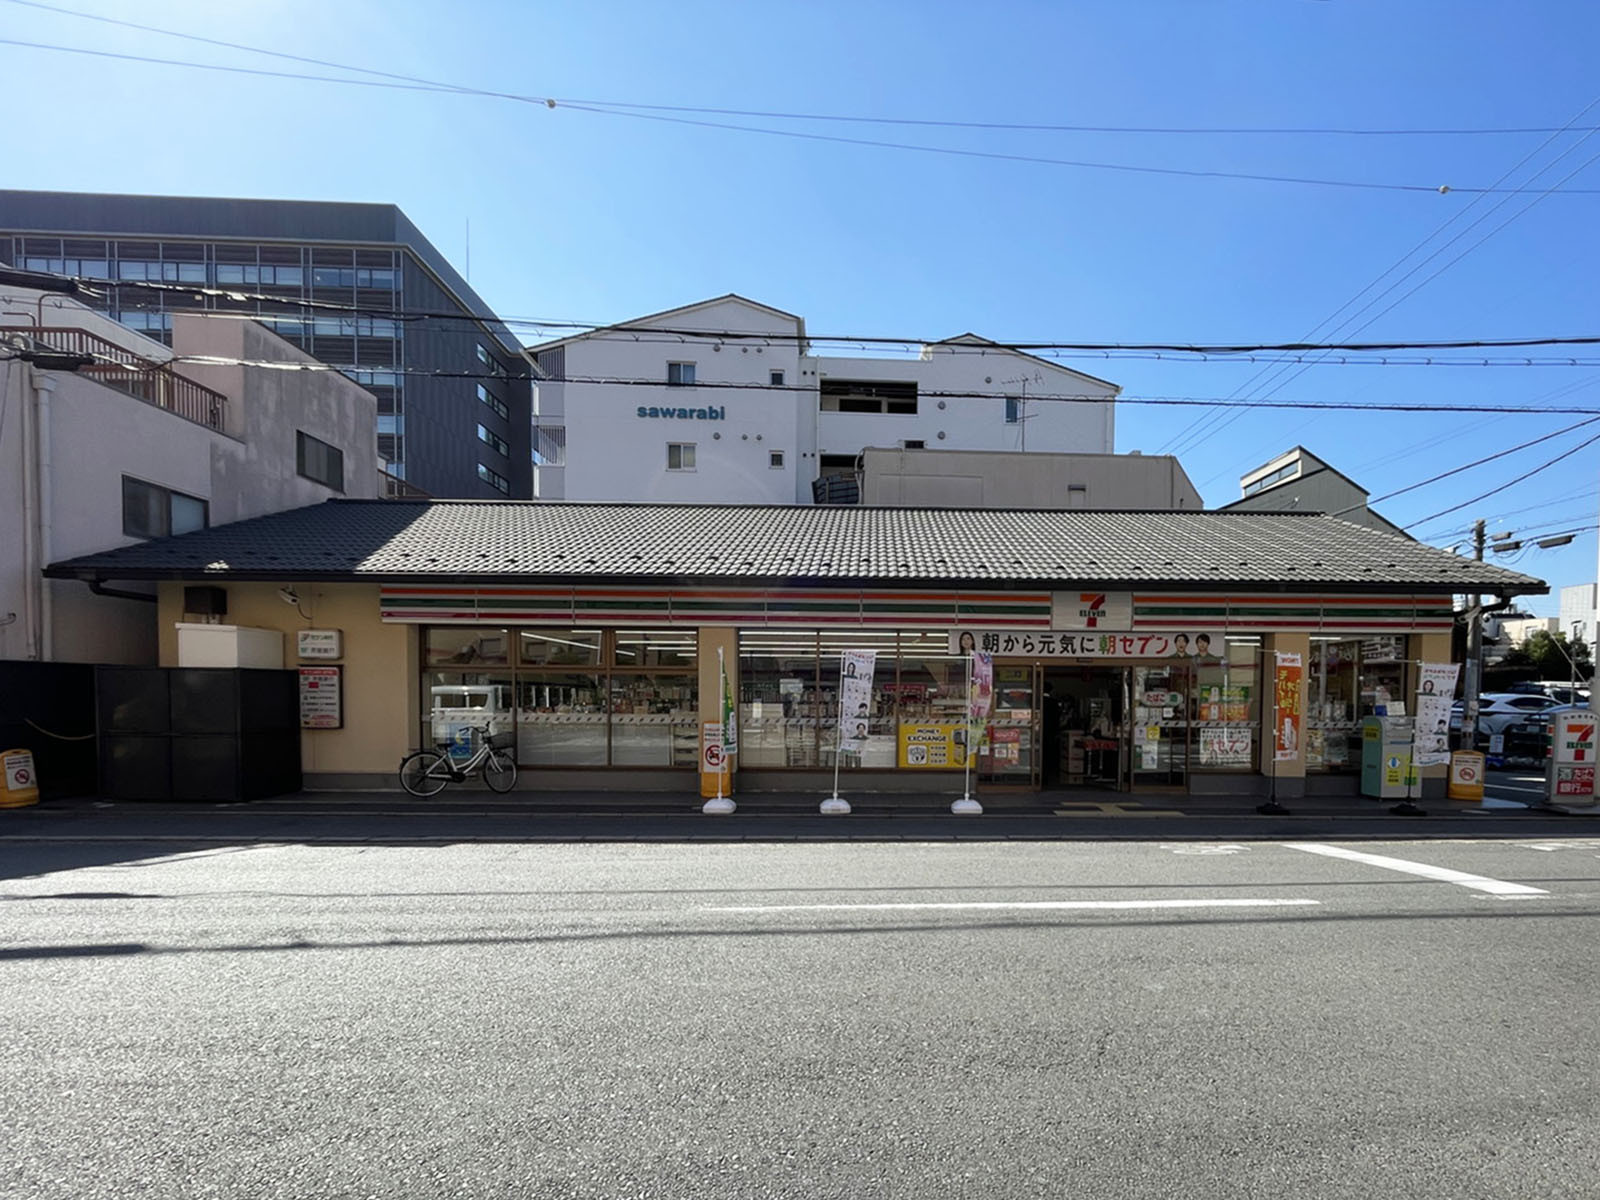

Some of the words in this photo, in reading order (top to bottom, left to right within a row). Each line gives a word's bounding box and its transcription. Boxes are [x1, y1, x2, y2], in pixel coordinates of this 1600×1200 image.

[637, 406, 725, 420] sawarabi
[1080, 593, 1106, 627] 7
[982, 633, 1169, 656] 朝から元気に朝セブン
[1567, 724, 1594, 761] 7
